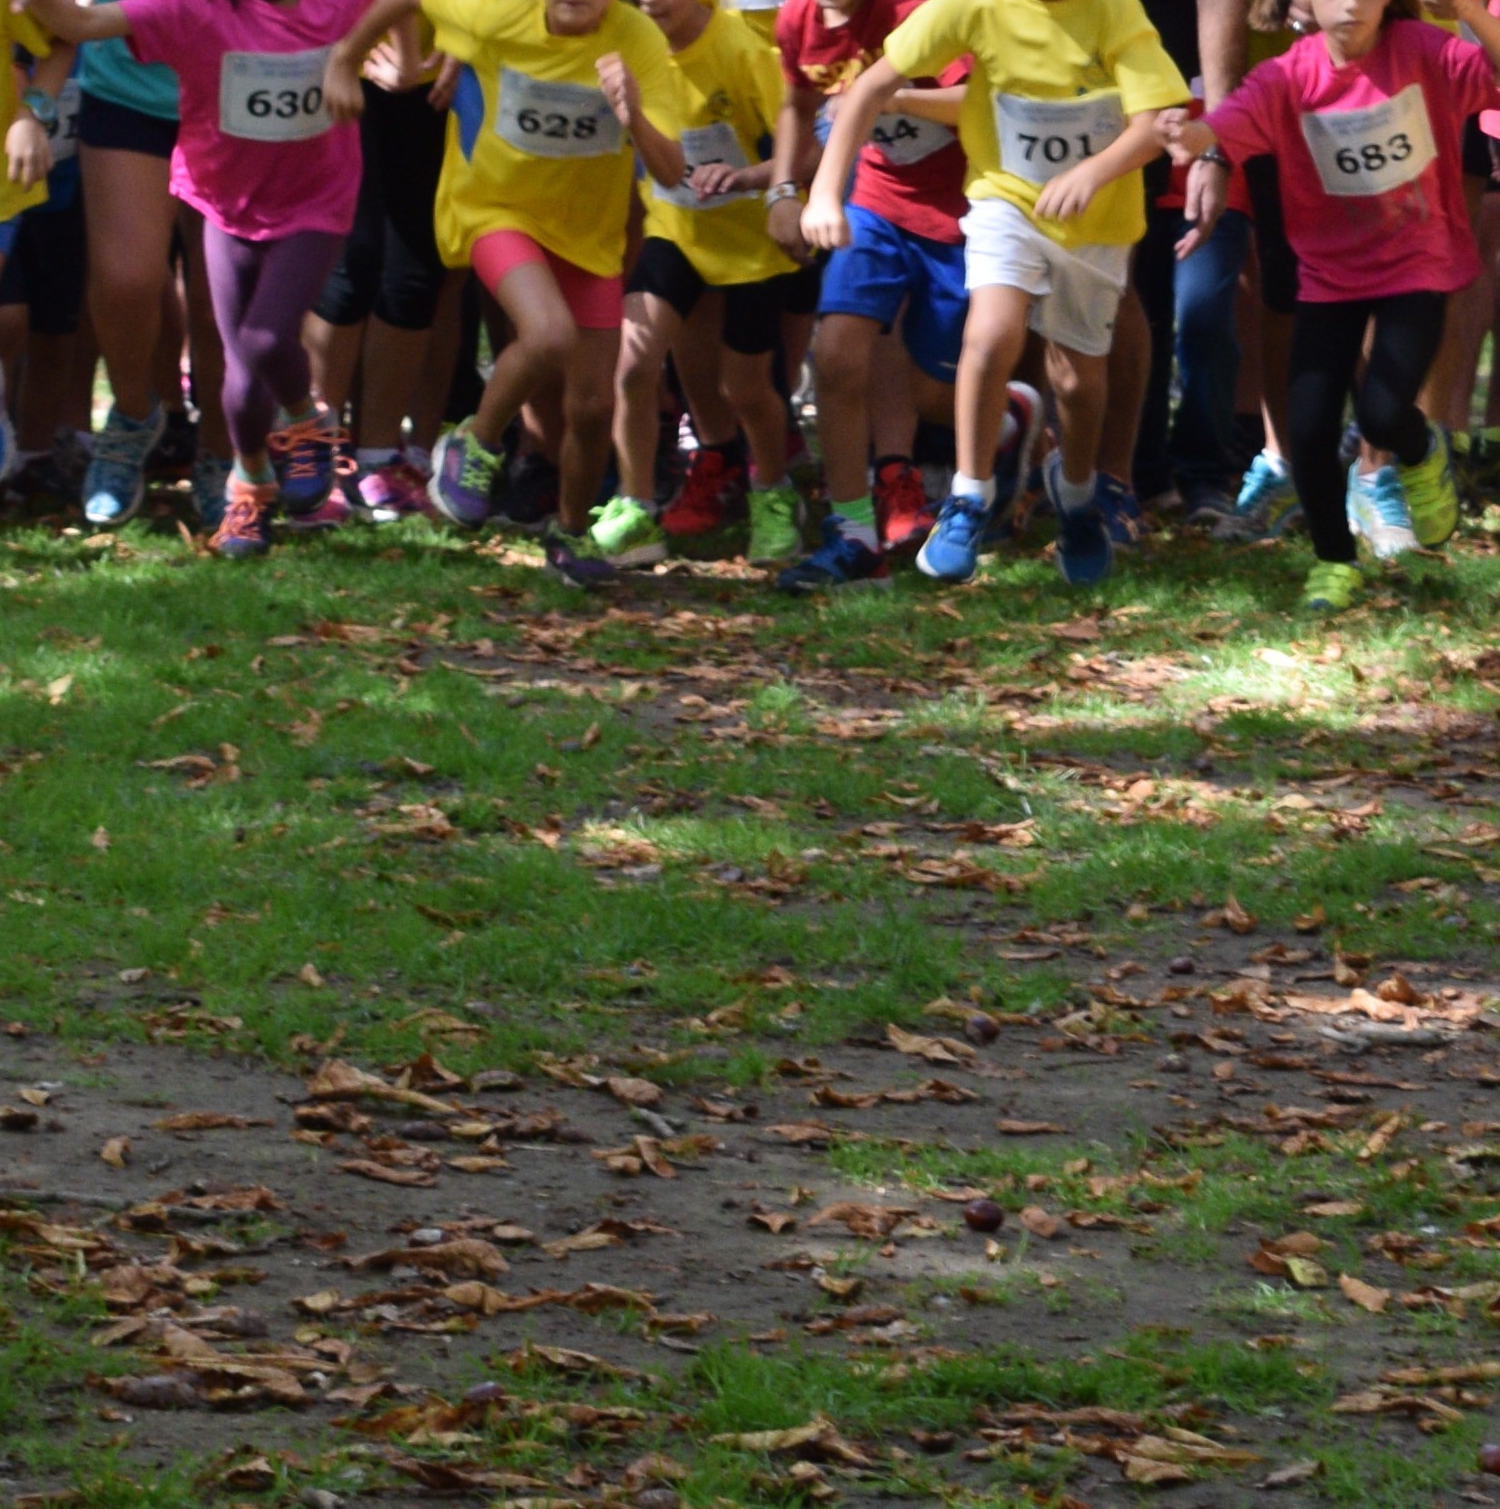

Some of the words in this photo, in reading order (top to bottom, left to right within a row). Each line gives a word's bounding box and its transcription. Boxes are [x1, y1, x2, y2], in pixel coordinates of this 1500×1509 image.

[247, 86, 323, 119] 630
[517, 108, 598, 139] 628
[872, 119, 919, 146] 44
[1018, 132, 1093, 164] 701
[1336, 133, 1412, 175] 683
